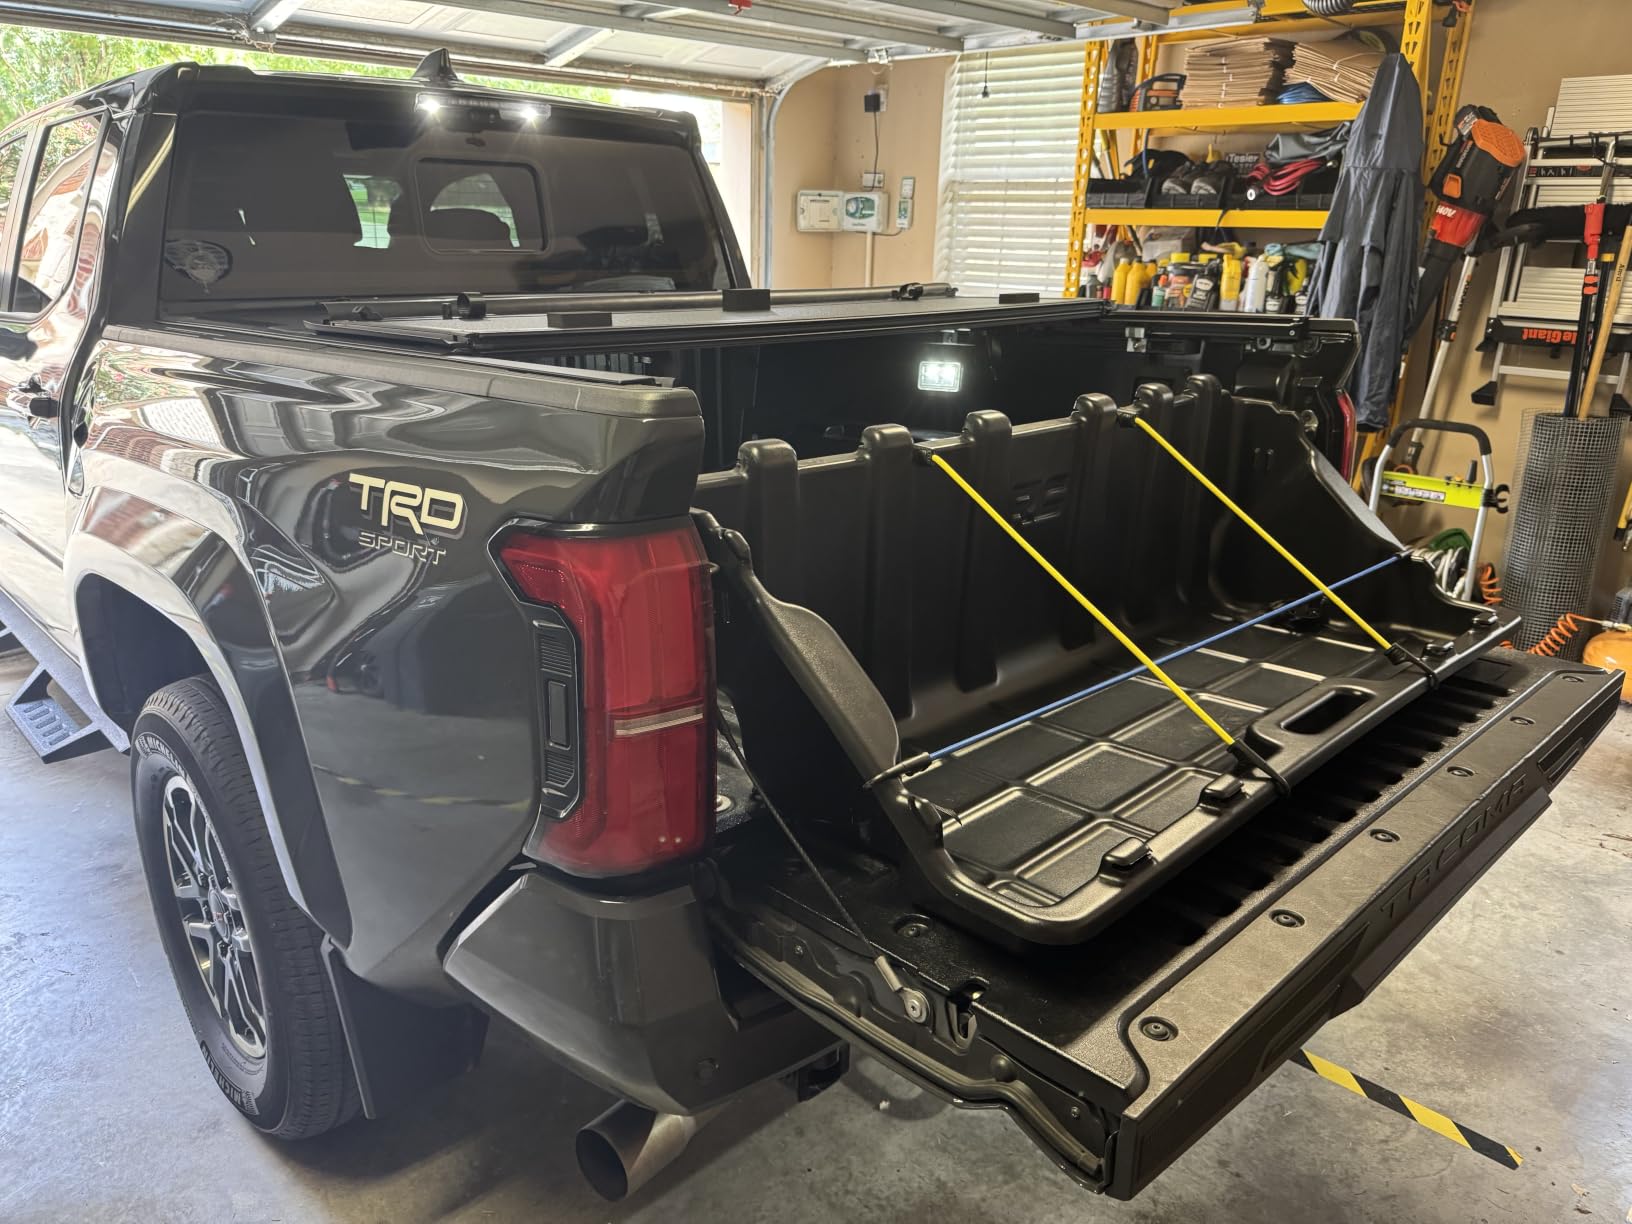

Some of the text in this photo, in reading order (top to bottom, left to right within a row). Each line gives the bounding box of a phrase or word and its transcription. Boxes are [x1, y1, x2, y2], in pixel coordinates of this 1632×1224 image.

[1522, 328, 1562, 343] Giant
[349, 473, 464, 535] TRD
[359, 532, 446, 565] SPORT
[1380, 773, 1527, 919] TACOMA
[201, 1044, 242, 1105] MICHELIN
